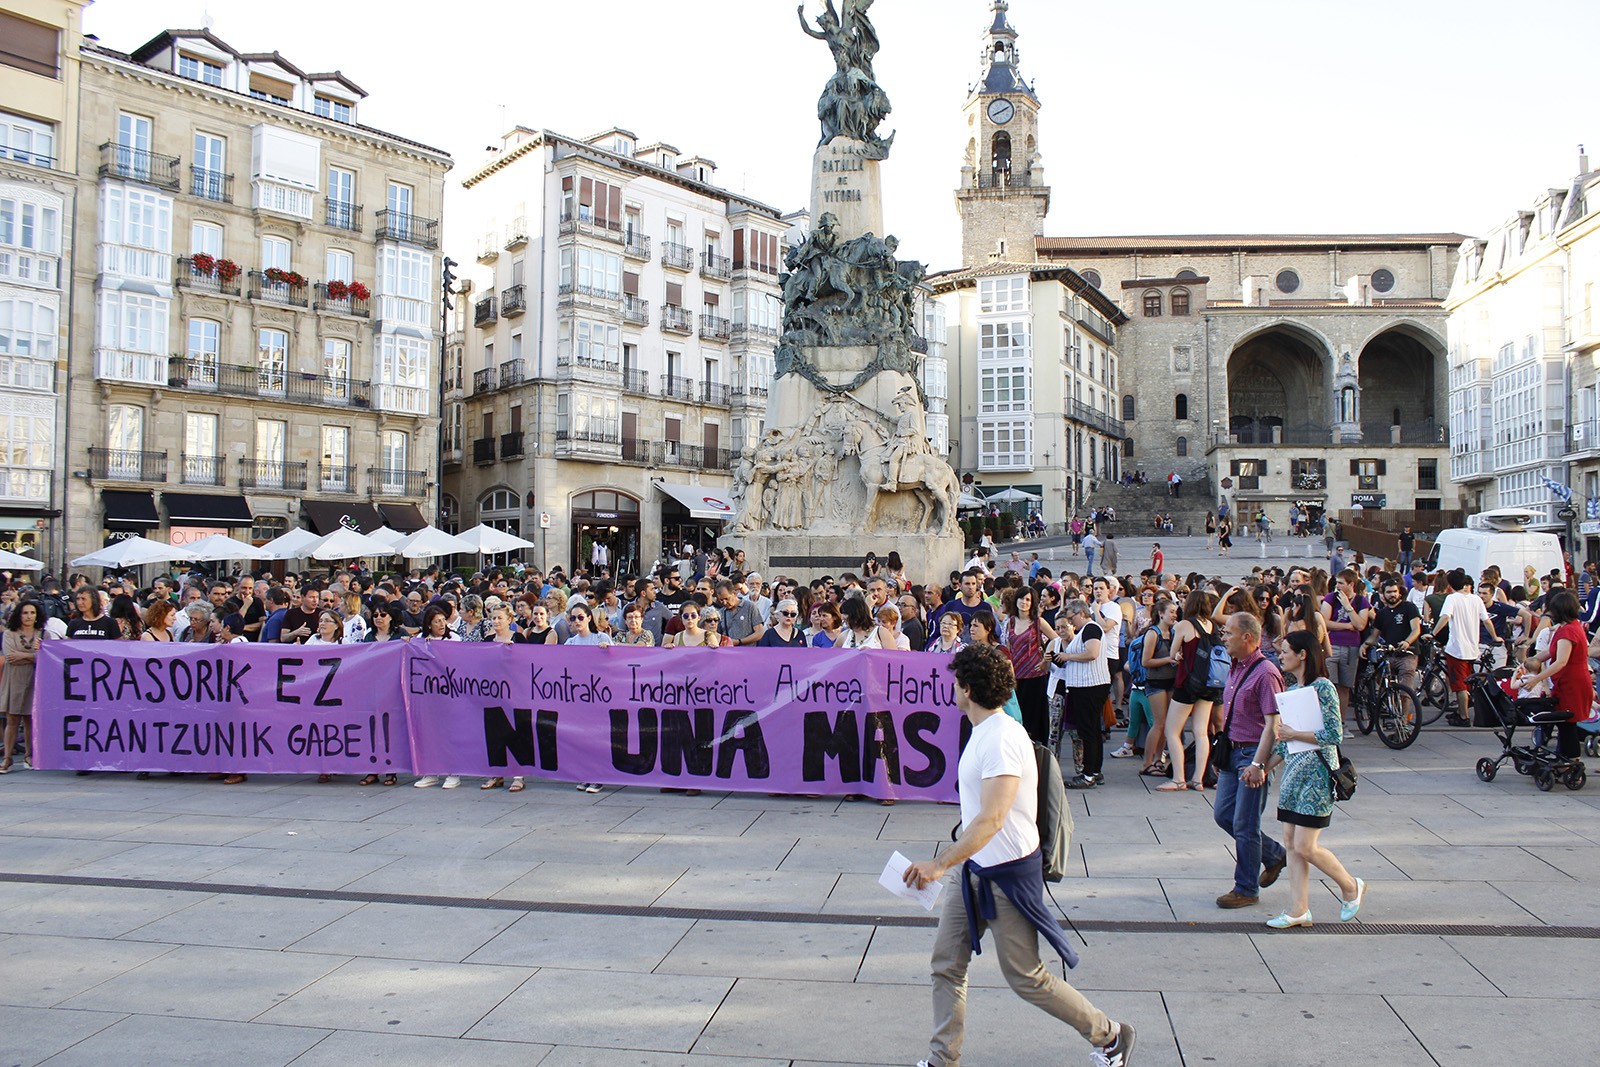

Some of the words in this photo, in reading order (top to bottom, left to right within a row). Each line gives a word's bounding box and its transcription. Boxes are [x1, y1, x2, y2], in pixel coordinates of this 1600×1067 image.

[822, 159, 864, 172] BATALLA
[837, 176, 848, 185] DE
[824, 189, 862, 202] VITORIA
[63, 657, 252, 705] ERASORIK
[276, 657, 343, 706] EZ
[774, 664, 863, 704] Aurrea
[62, 715, 275, 758] ERANTZUNIK
[287, 712, 392, 765] GABE!!
[484, 707, 559, 772] NI
[609, 707, 770, 779] UNA
